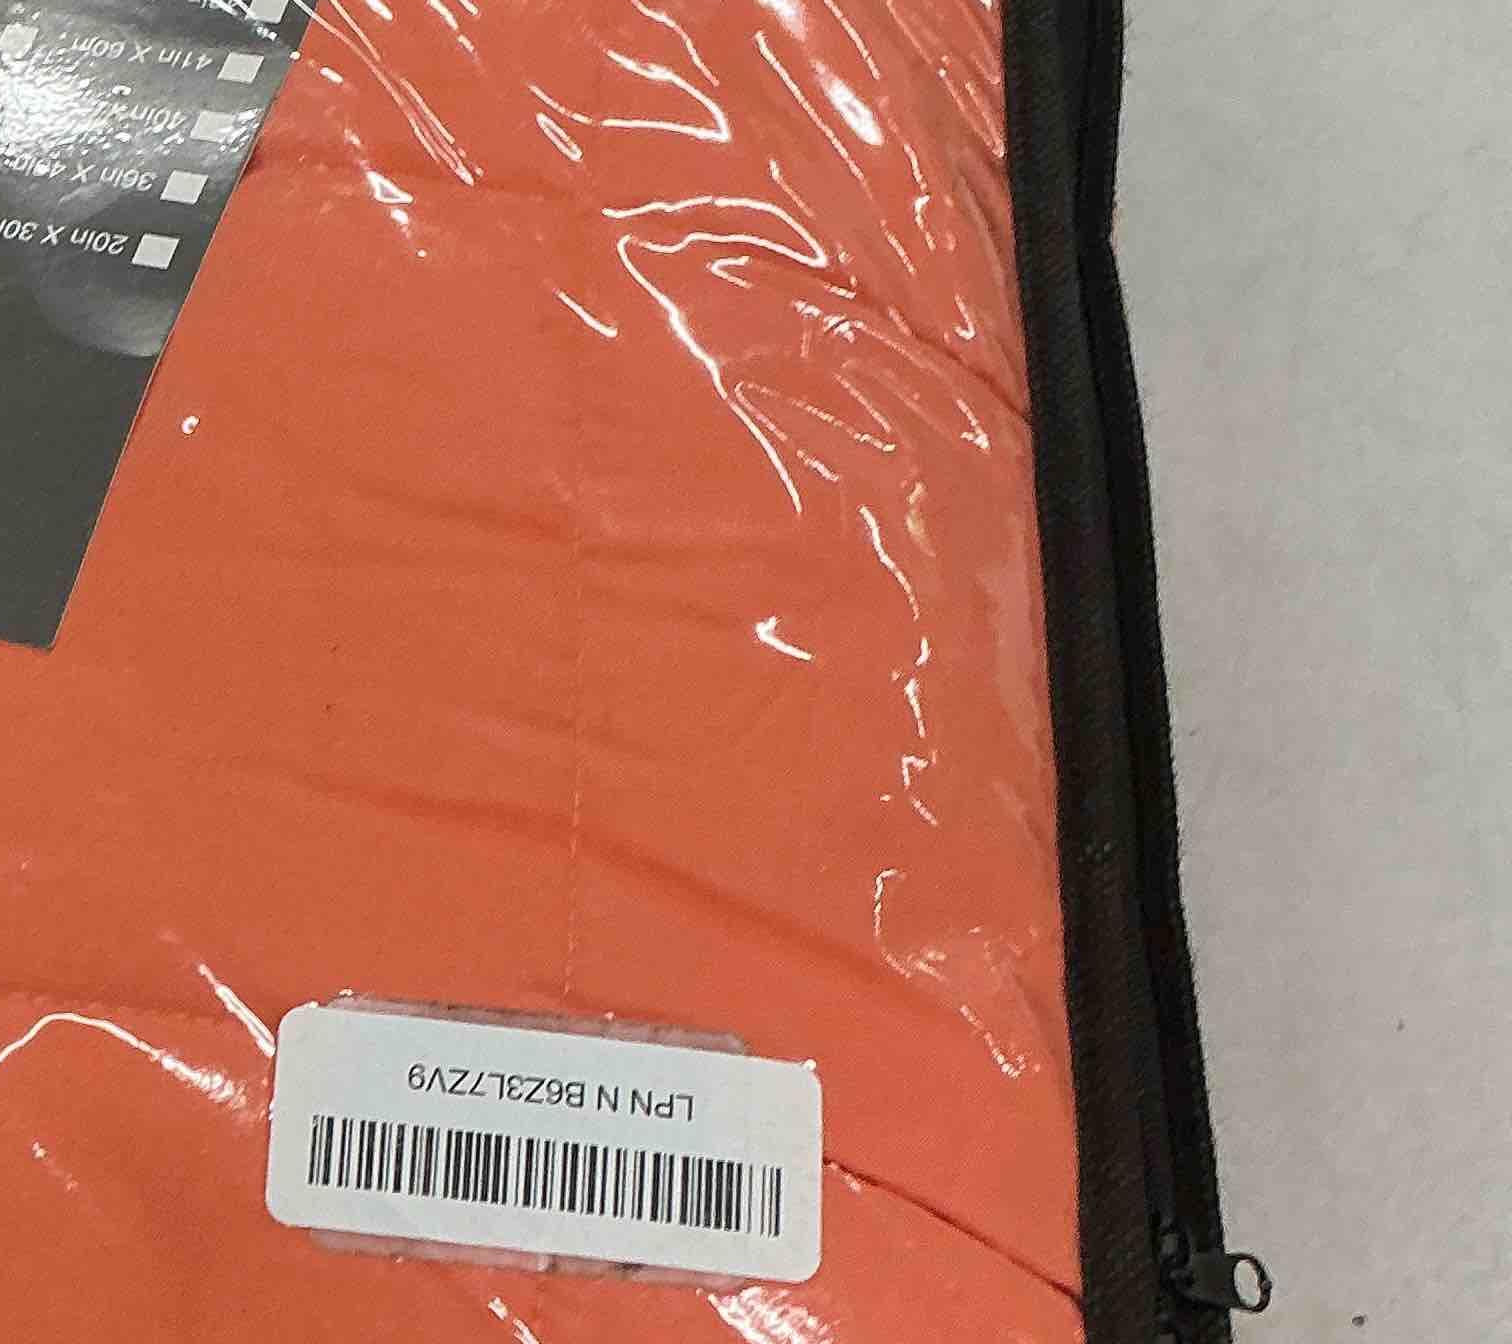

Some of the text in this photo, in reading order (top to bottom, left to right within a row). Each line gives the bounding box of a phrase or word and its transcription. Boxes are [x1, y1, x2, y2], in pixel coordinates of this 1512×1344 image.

[156, 46, 213, 71] 41in
[98, 166, 156, 191] 36in
[69, 227, 128, 254] 20in
[406, 1061, 693, 1123] LPN N B6Z3L7ZV9
